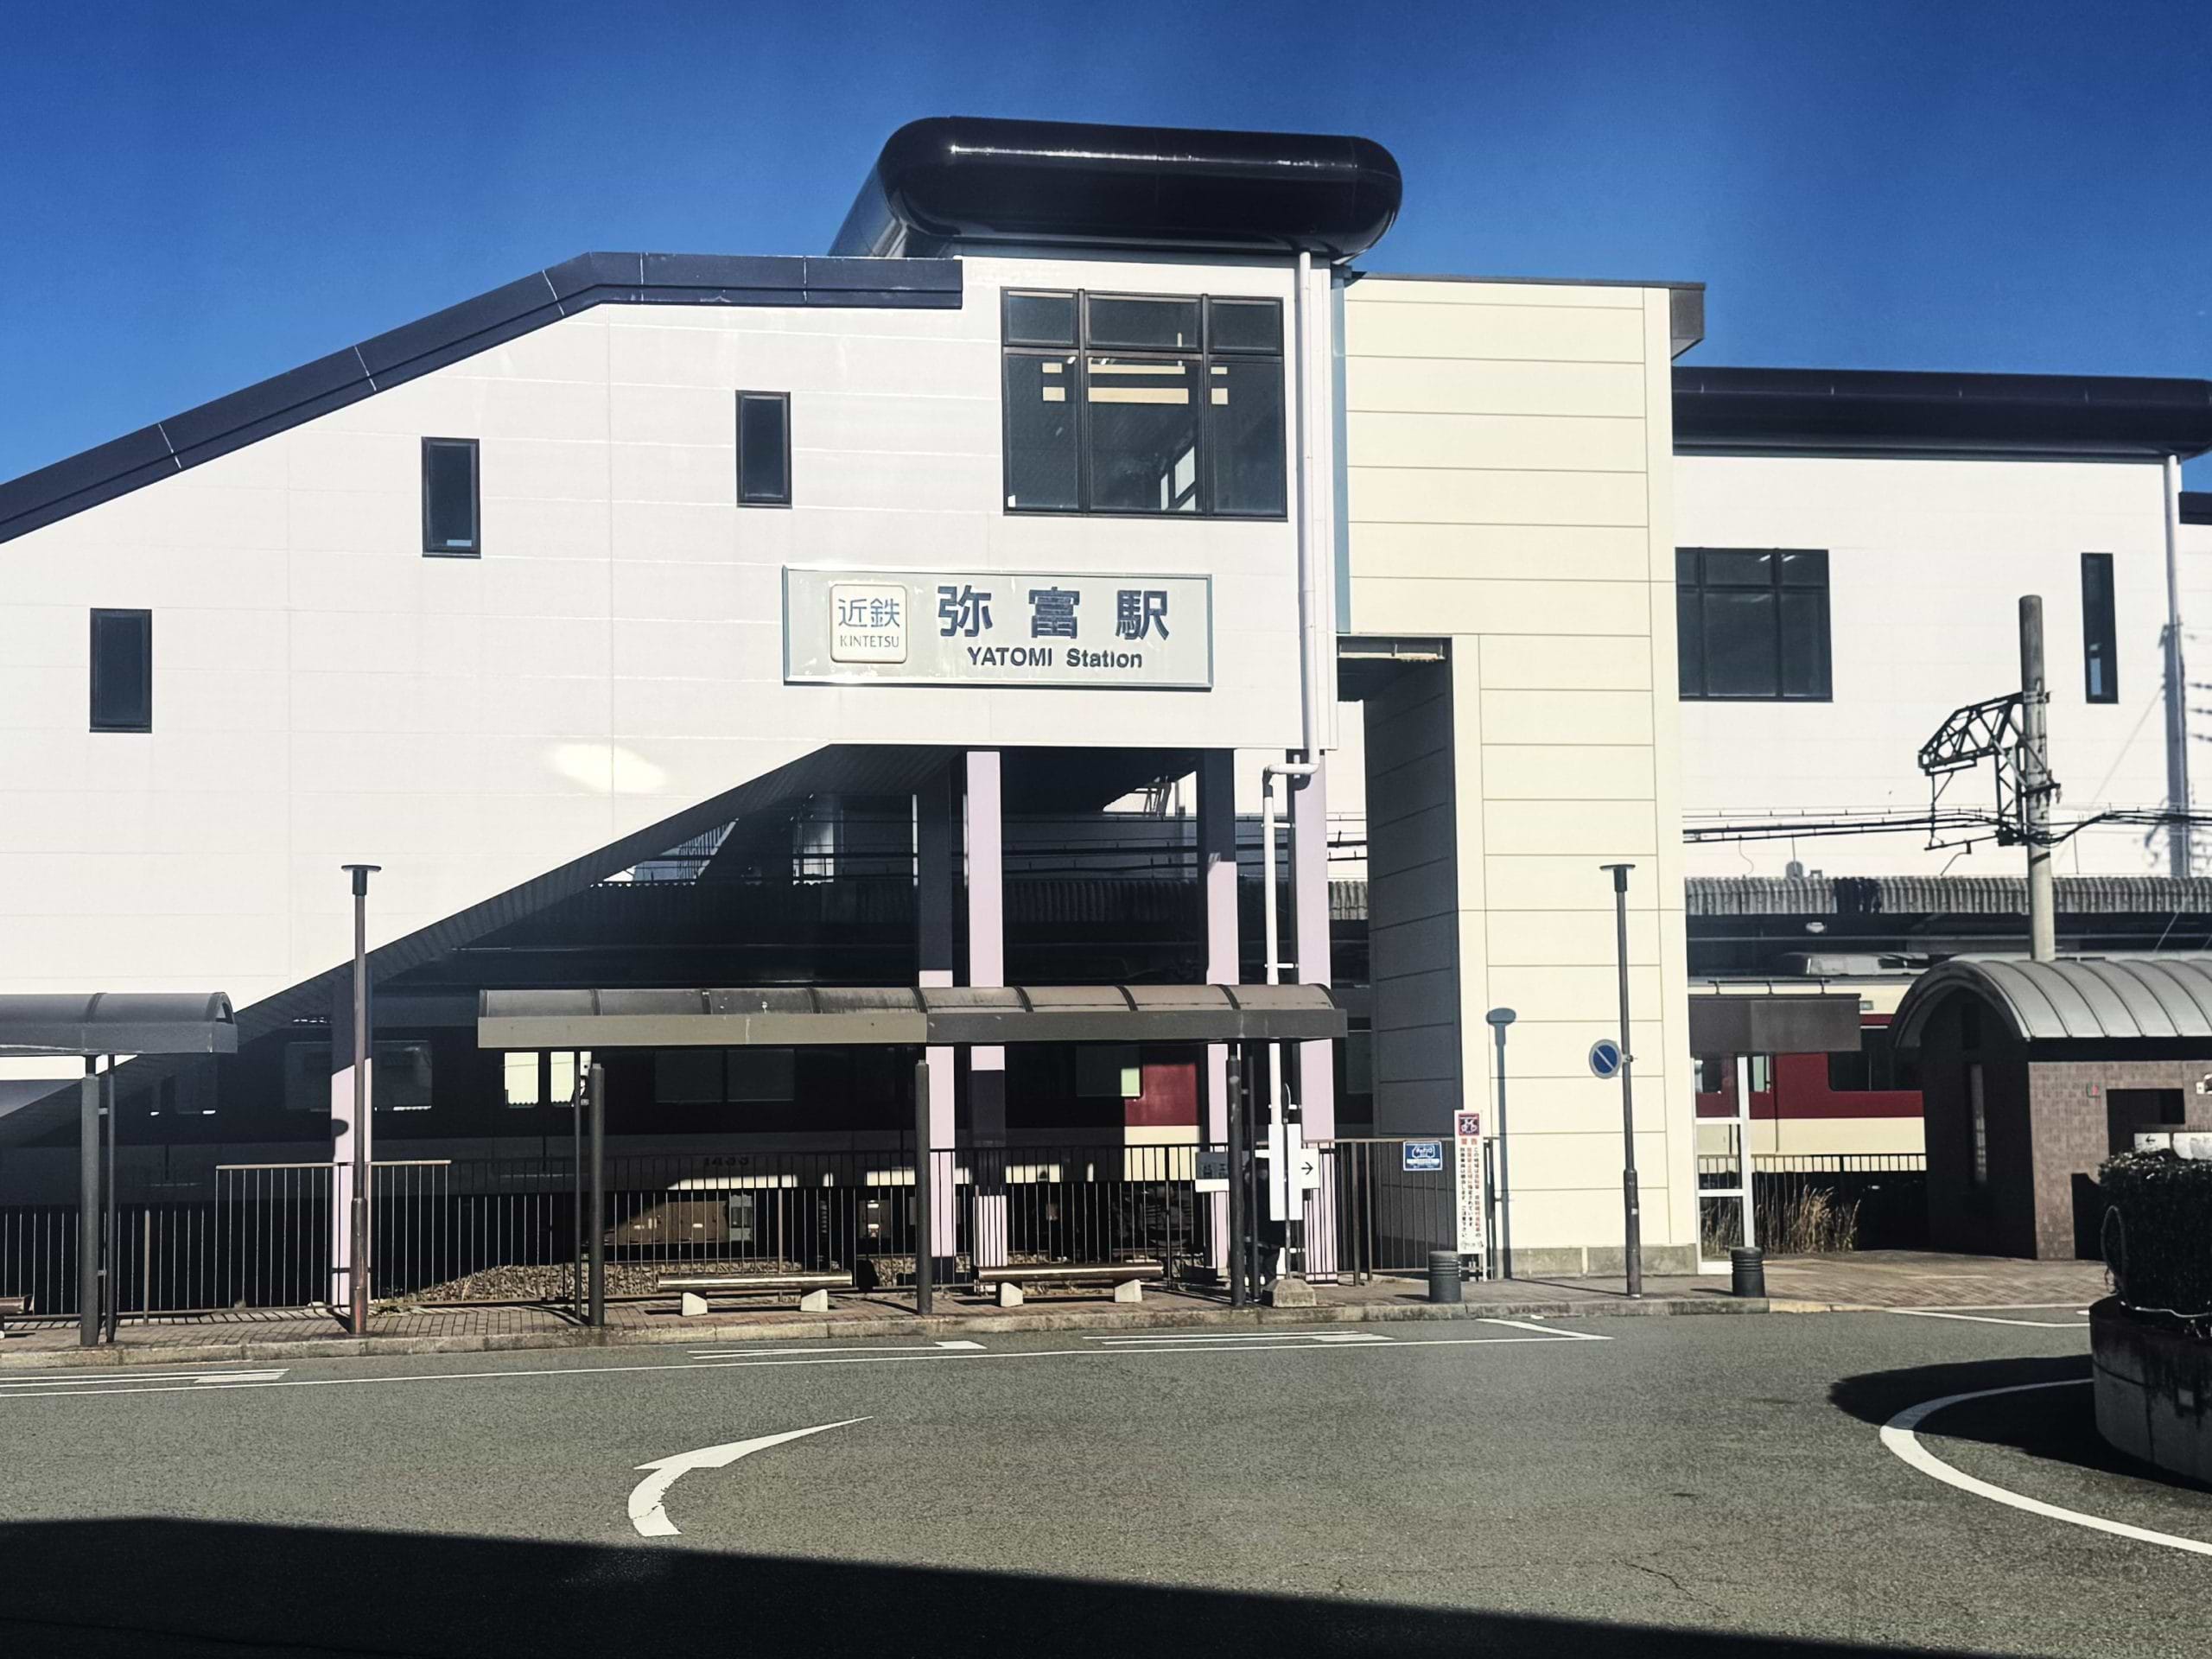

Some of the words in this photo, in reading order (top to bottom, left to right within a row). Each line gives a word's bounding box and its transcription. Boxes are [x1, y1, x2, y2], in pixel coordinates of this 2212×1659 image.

[838, 598, 900, 628] 近鉄
[937, 585, 1170, 640] 弥富駅
[840, 635, 899, 647] KINTETSU
[967, 646, 1052, 666] YATOMI
[1066, 648, 1142, 668] Station
